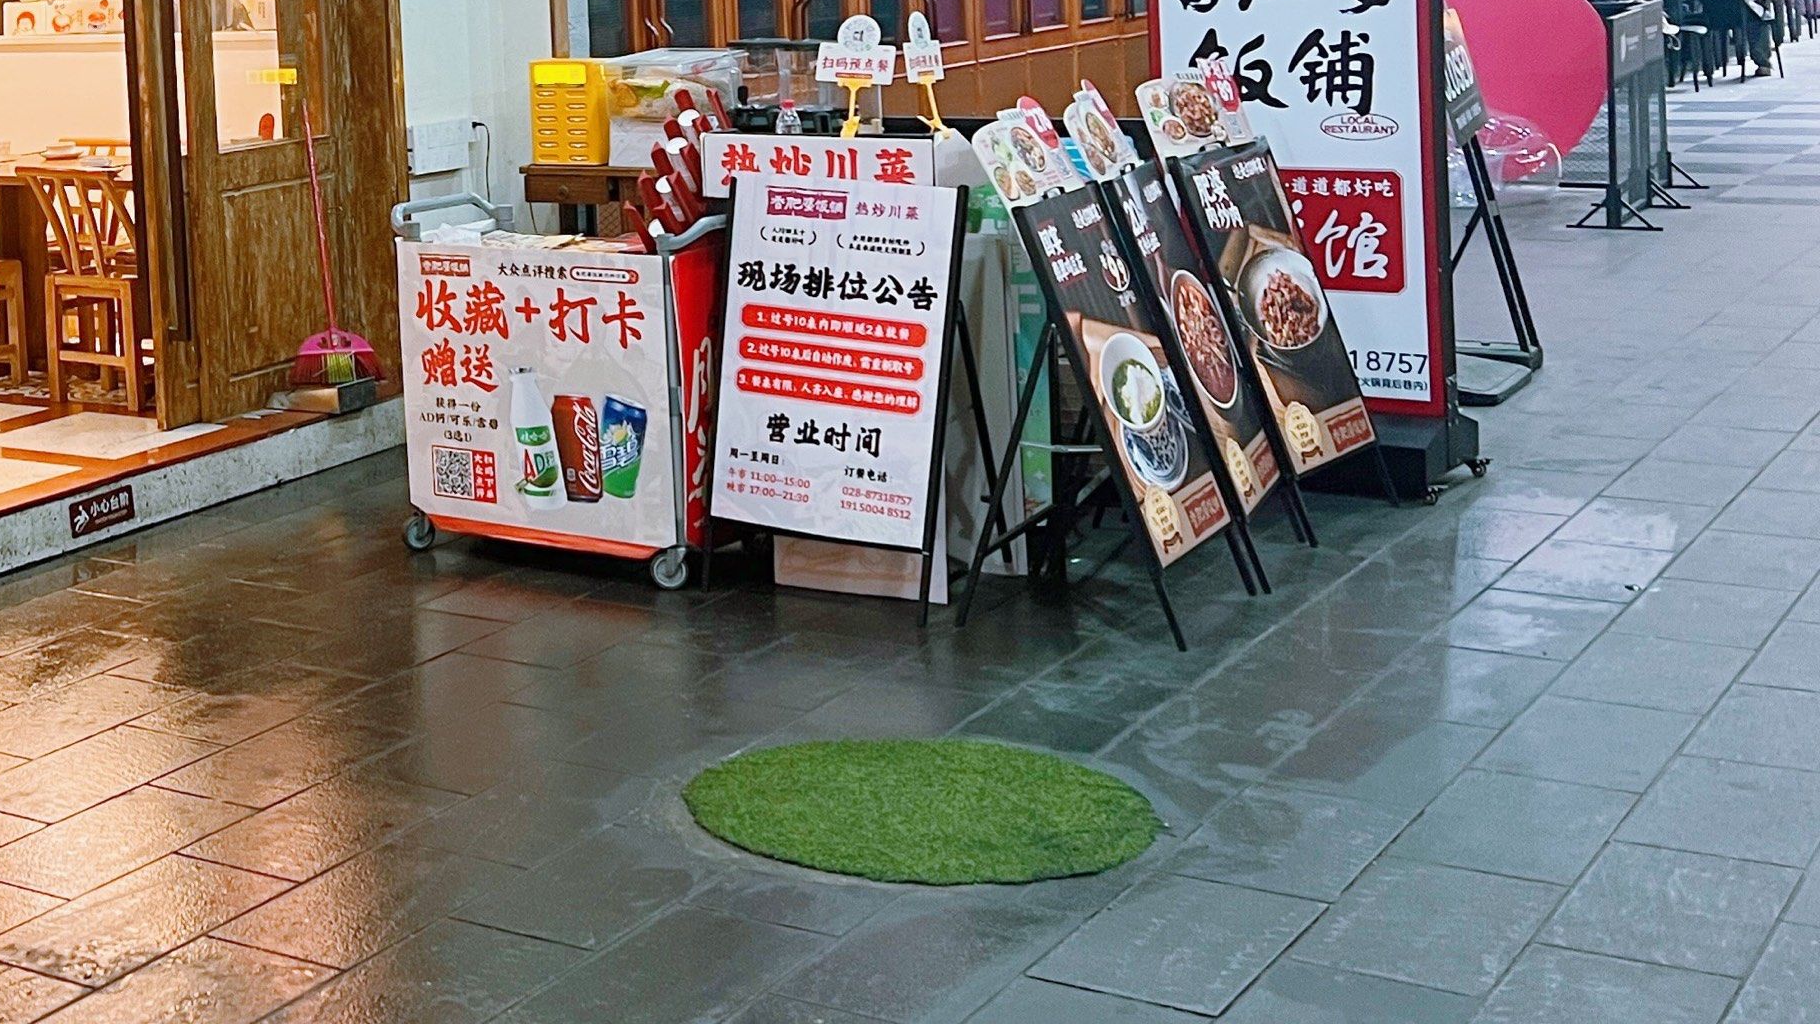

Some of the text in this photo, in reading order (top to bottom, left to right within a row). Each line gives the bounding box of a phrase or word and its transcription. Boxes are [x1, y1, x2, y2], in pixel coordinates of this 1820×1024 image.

[1324, 125, 1396, 136] RESTAURANT
[1340, 115, 1378, 126] LOCAL
[737, 259, 939, 311] 现场排位公告
[415, 278, 646, 350] 收藏+打卡
[420, 336, 500, 393] 赠送
[765, 412, 882, 458] 营业时间
